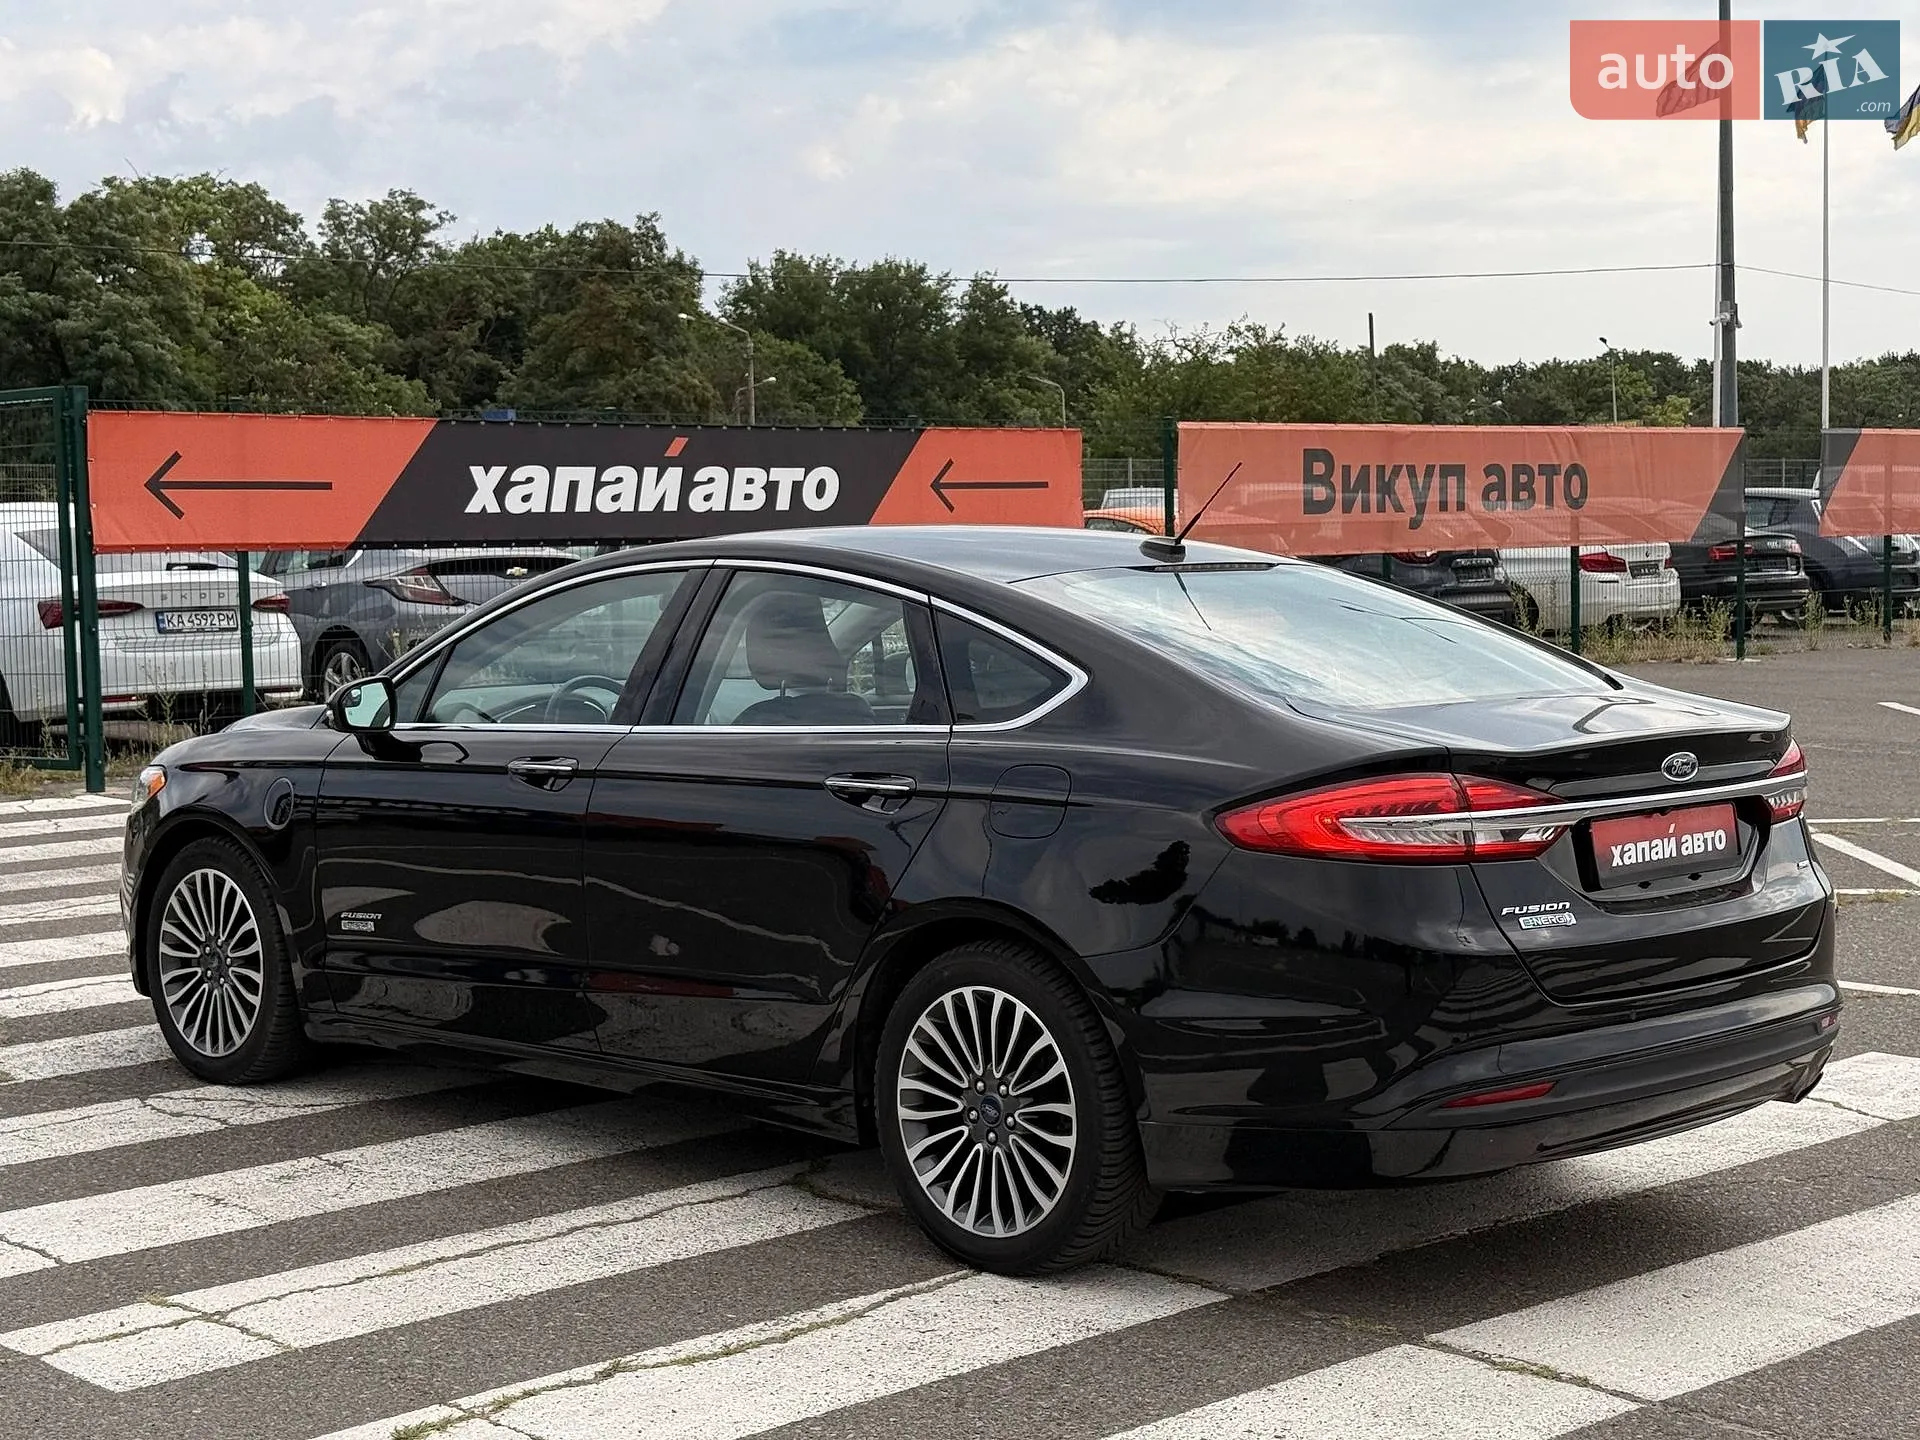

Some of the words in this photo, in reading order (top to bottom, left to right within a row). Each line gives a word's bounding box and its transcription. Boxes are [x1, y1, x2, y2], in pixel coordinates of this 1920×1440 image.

[688, 466, 840, 512] авто
[1302, 448, 1466, 530] Викуп
[1481, 462, 1589, 511] авто
[1680, 828, 1727, 856] авто
[1501, 901, 1570, 916] FUSION
